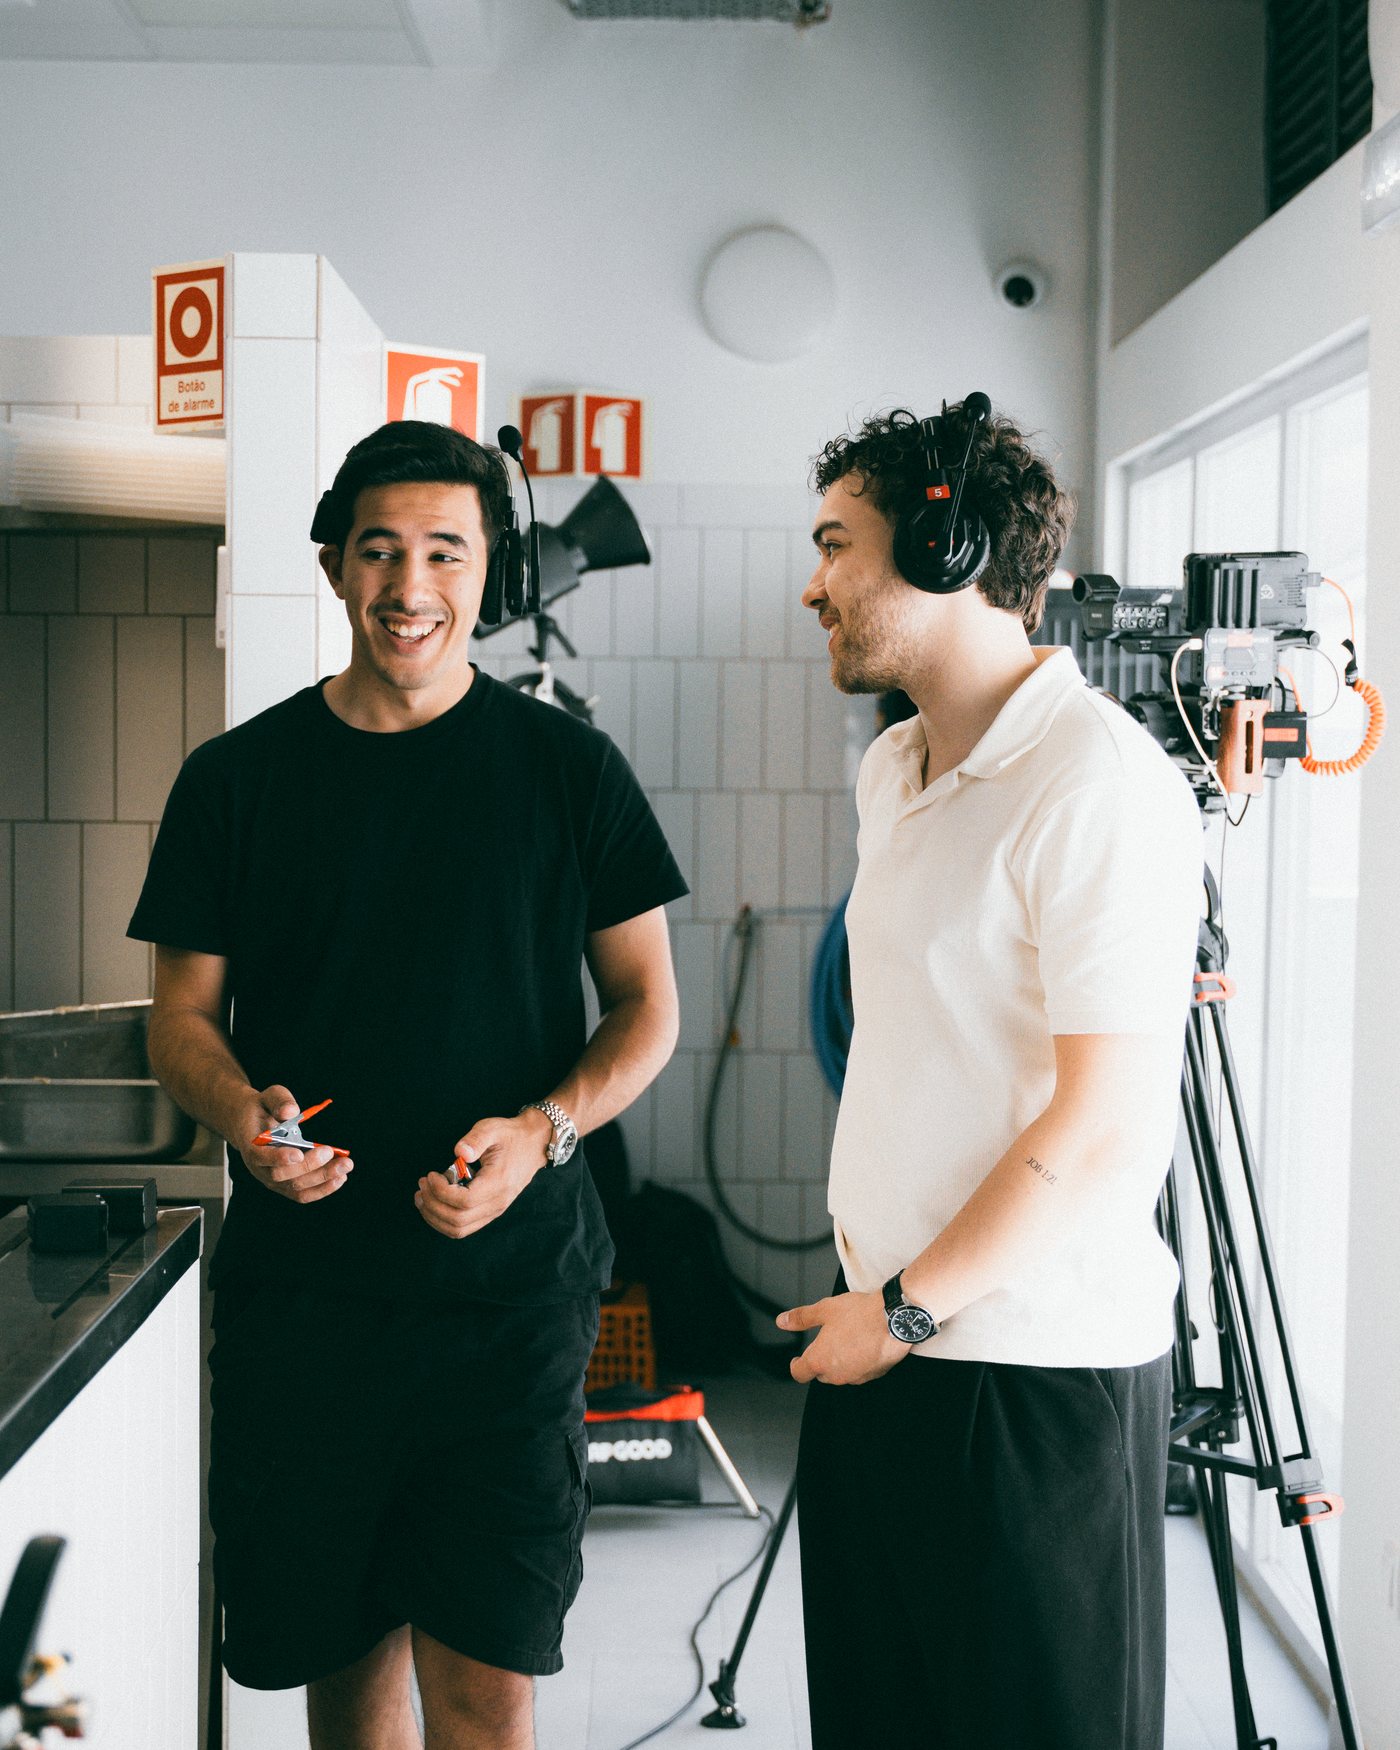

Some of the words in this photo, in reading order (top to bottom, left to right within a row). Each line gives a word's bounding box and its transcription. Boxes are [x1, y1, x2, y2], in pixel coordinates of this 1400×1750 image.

[178, 379, 206, 393] Botão
[168, 400, 180, 412] de
[183, 399, 215, 411] alarme
[934, 488, 943, 498] 5
[1025, 1156, 1043, 1173] JOB
